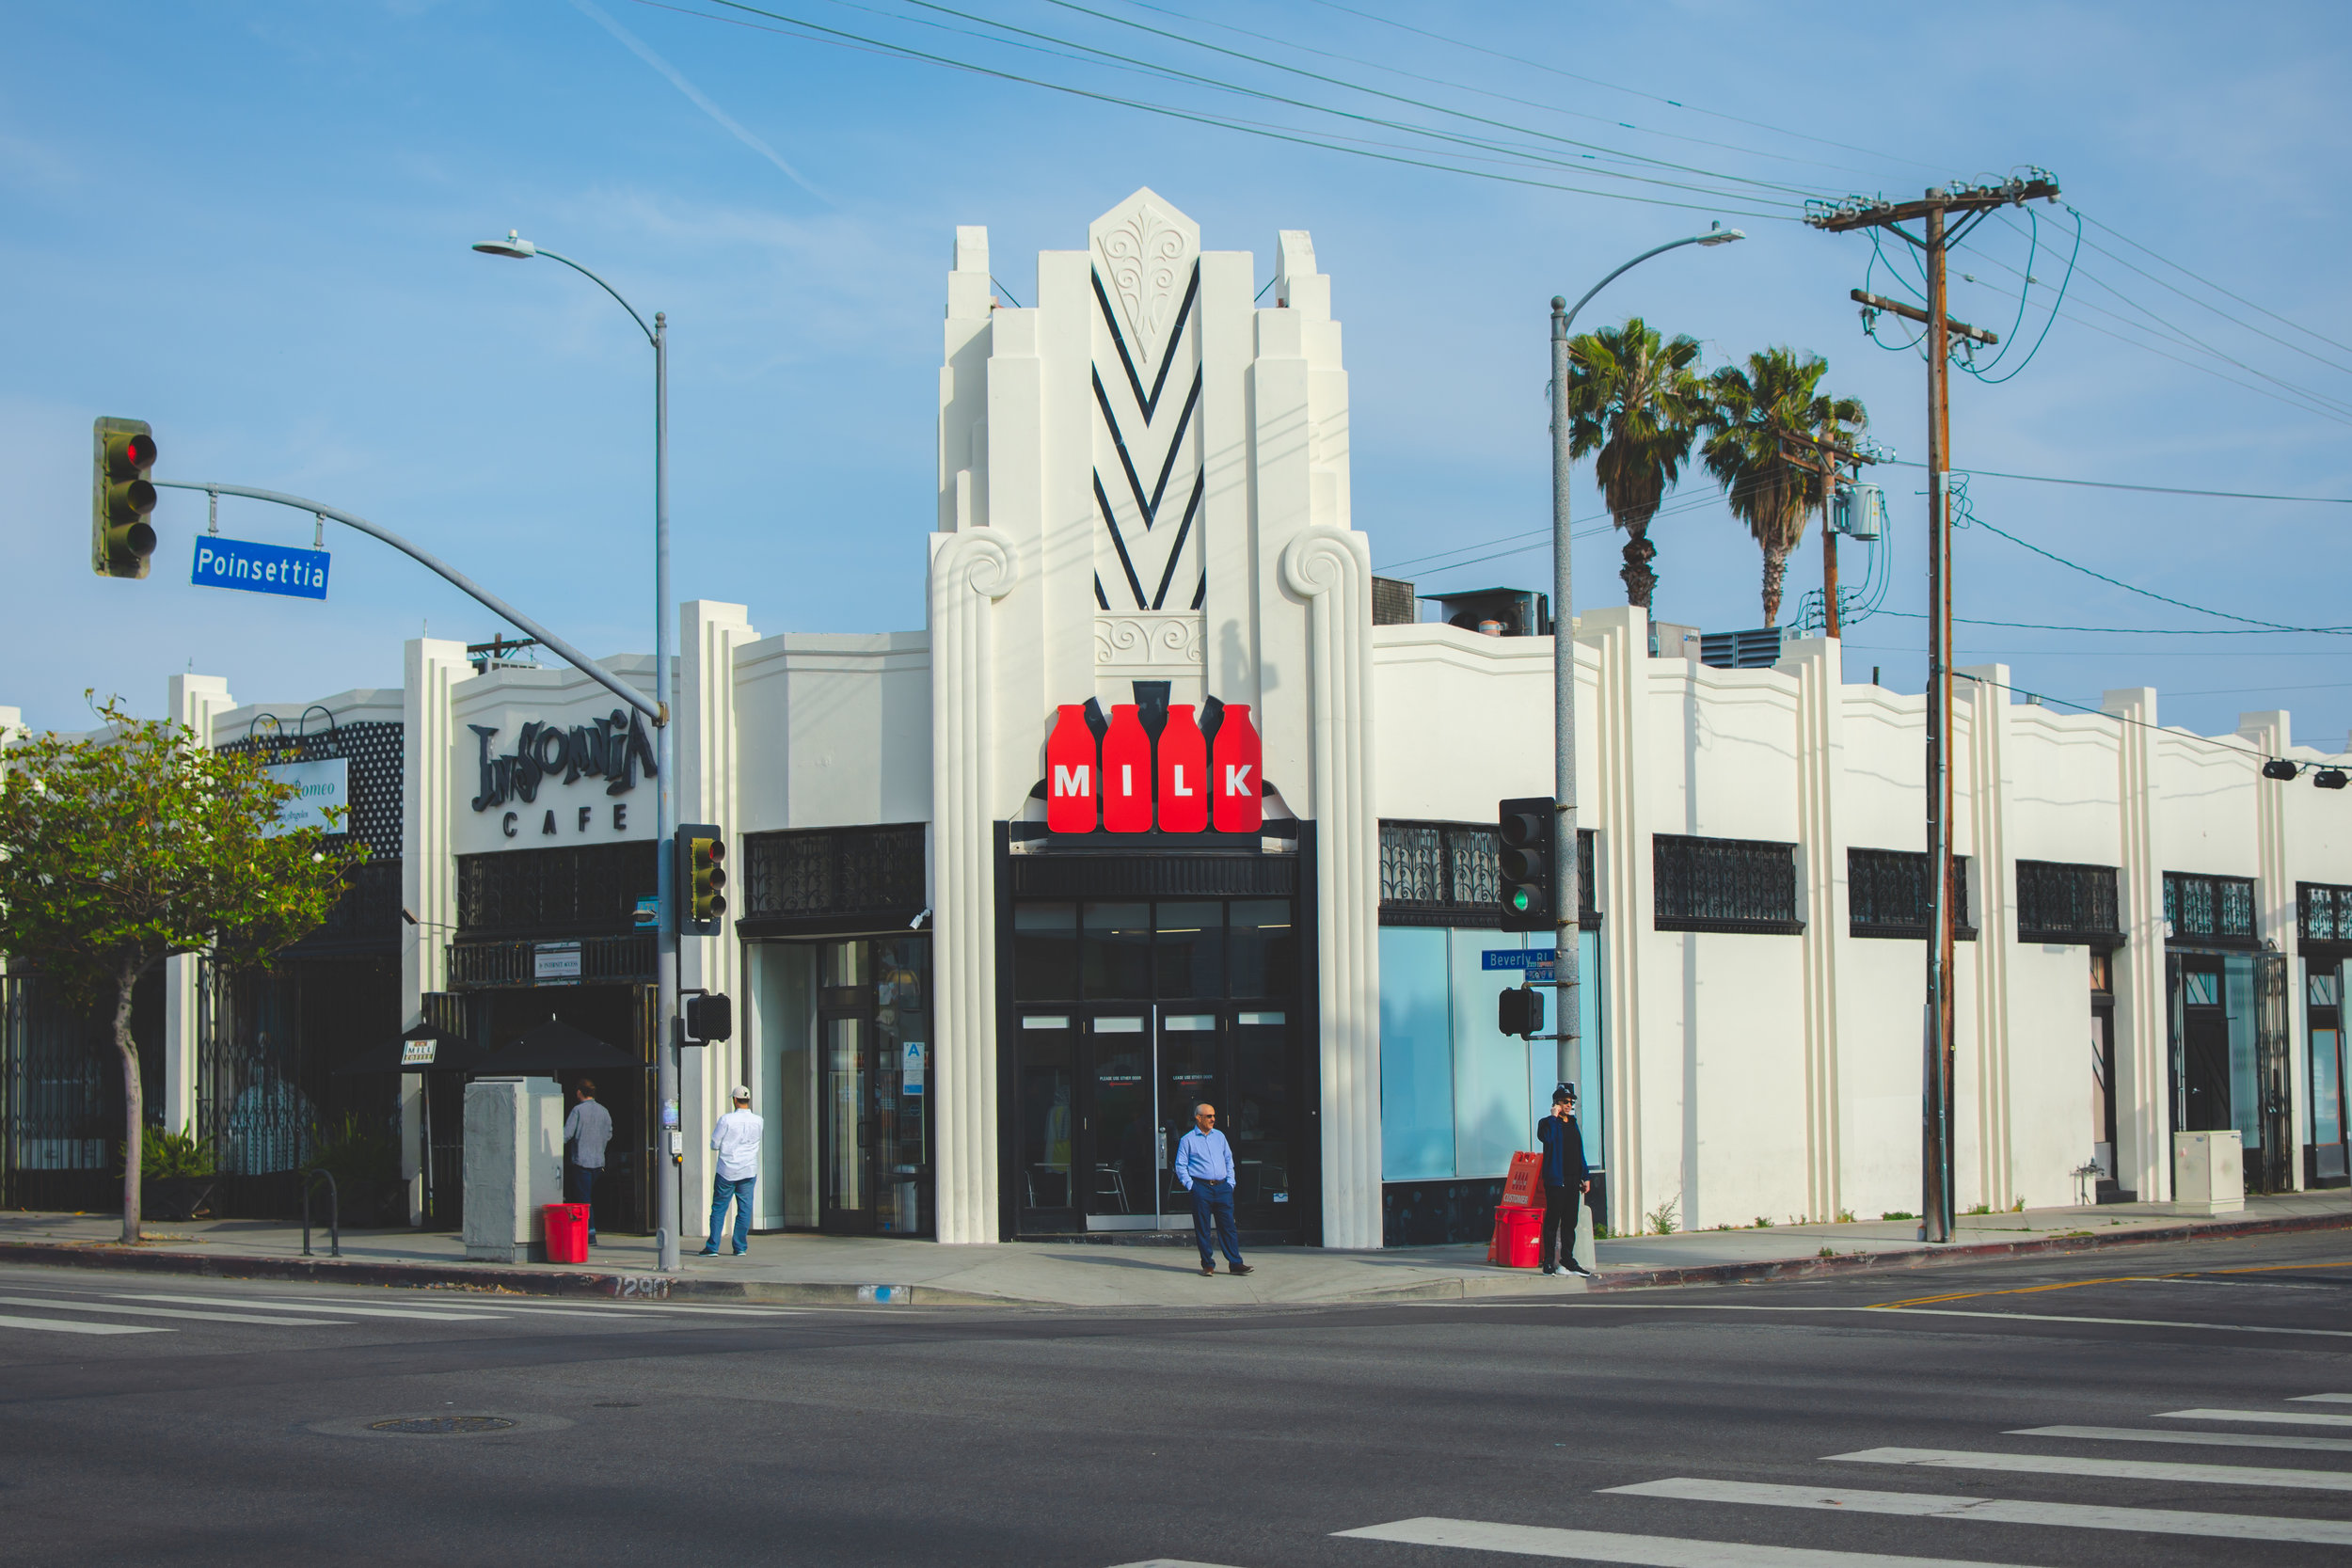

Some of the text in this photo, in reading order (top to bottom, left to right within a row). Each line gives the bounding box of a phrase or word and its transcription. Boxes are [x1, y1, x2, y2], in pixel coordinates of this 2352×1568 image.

[198, 548, 325, 588] Poinsettia
[1054, 764, 1253, 798] MILK
[502, 803, 627, 837] CAFE
[1490, 953, 1531, 967] Beverly
[908, 1043, 920, 1056] A
